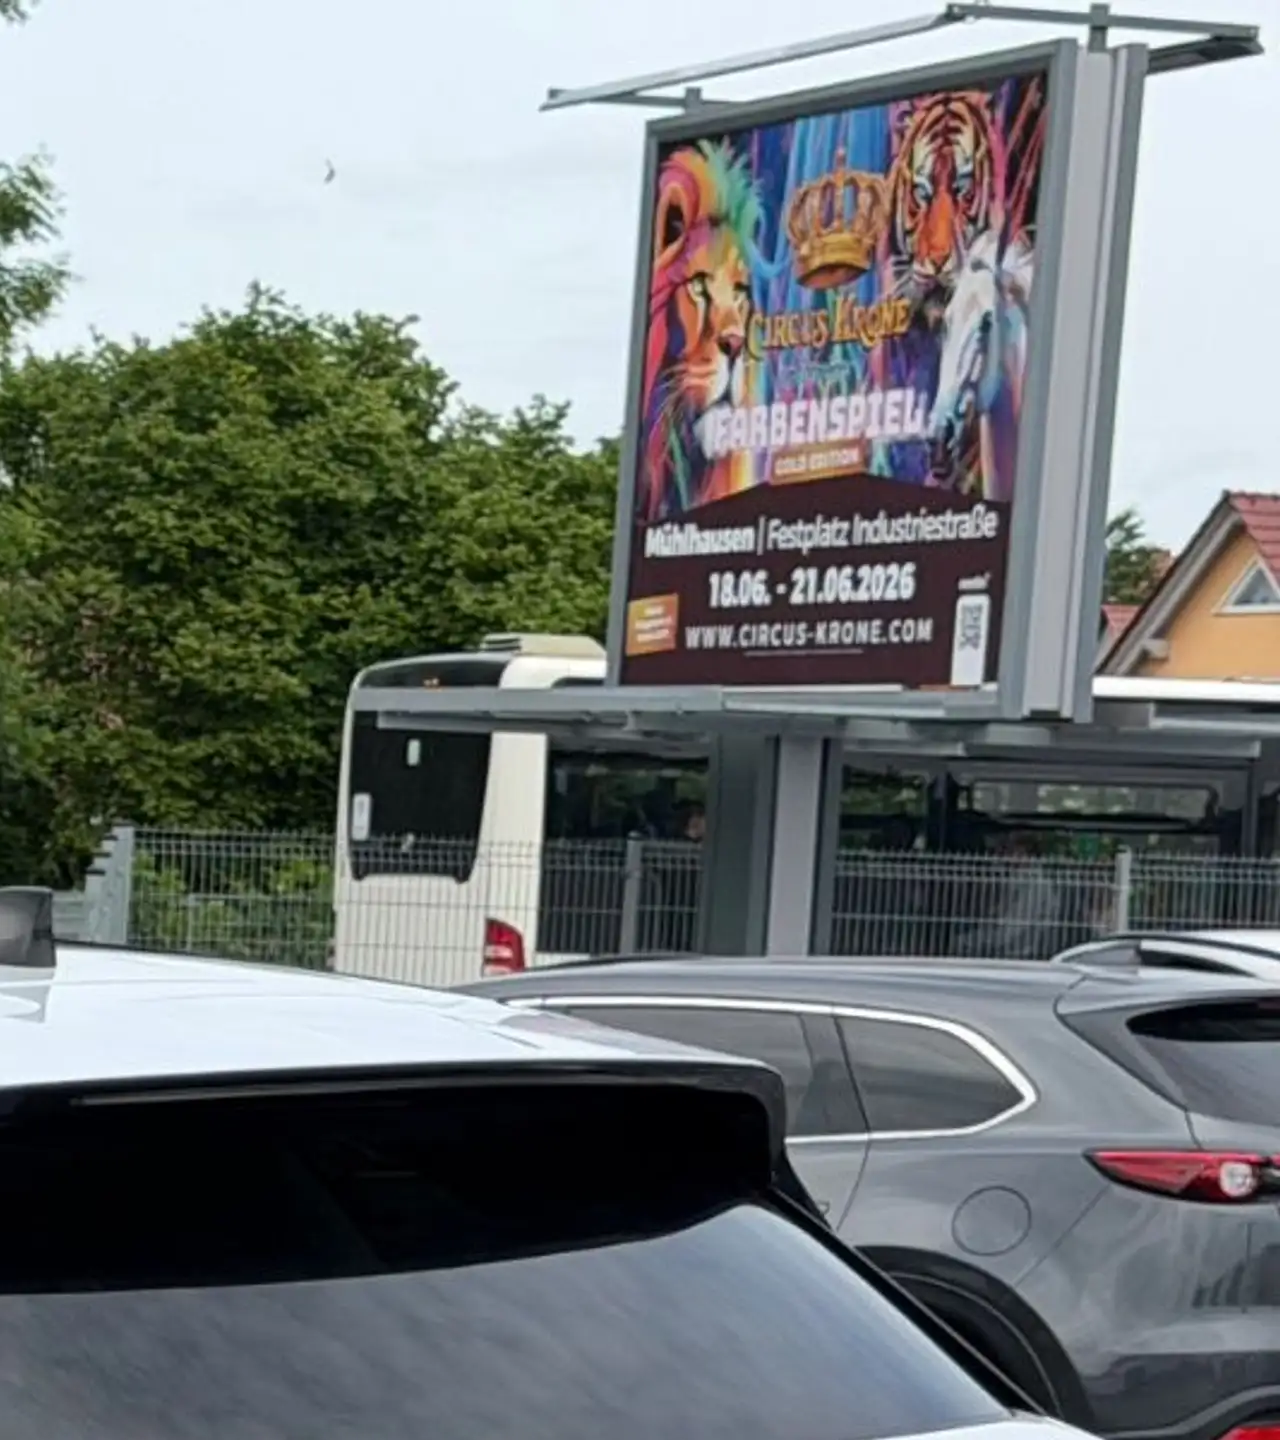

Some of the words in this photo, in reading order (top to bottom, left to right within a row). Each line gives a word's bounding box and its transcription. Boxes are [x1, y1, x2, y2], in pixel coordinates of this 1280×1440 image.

[644, 522, 755, 558] Mühlhausen
[767, 514, 850, 556] Festplatz
[852, 503, 999, 546] Industriestraße
[709, 570, 771, 608] 18.06.
[789, 562, 916, 604] 21.06.2026
[685, 617, 934, 648] WWW.CIRCUS-KRONE.COM
